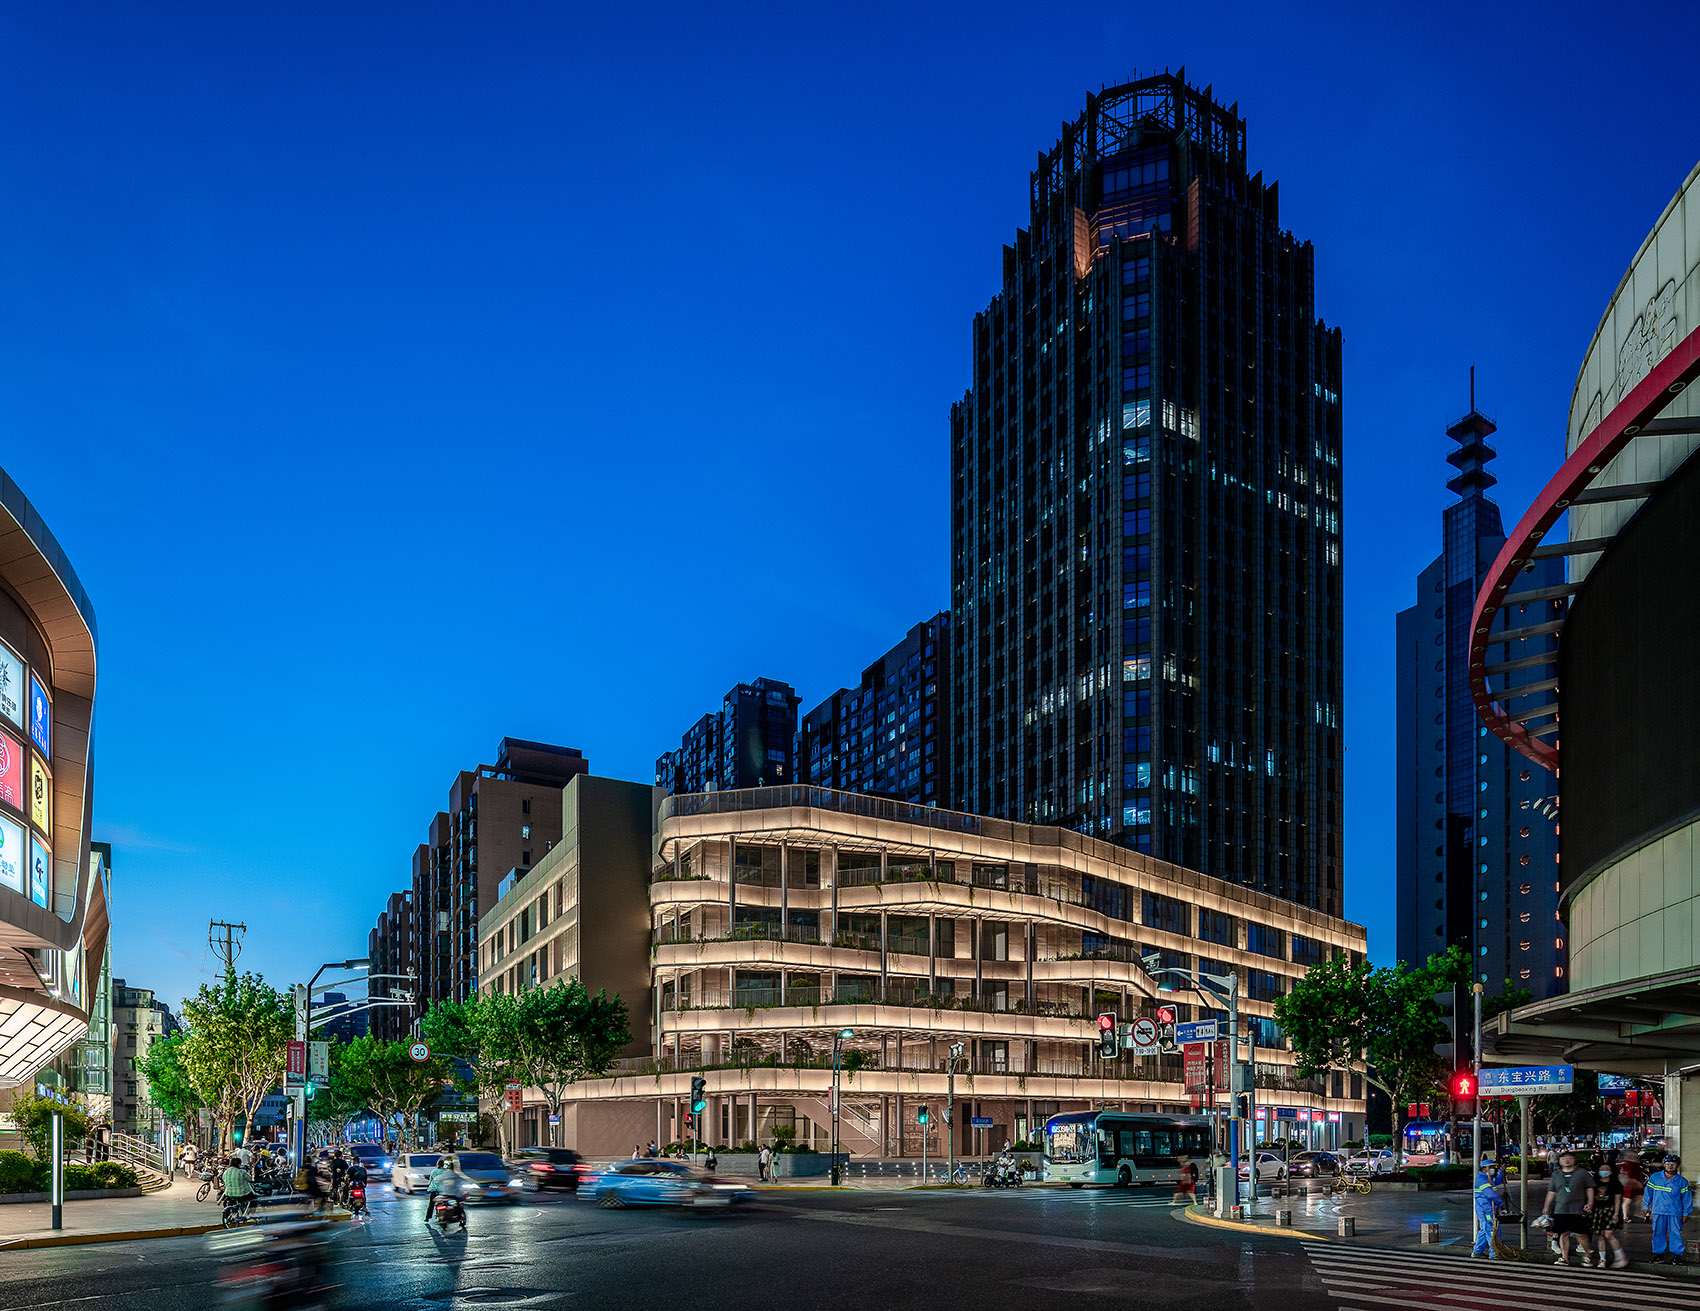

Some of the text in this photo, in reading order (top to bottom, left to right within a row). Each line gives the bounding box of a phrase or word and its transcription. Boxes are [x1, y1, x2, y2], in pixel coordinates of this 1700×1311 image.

[414, 1048, 425, 1056] 30
[1498, 1070, 1551, 1083] 东宝兴路
